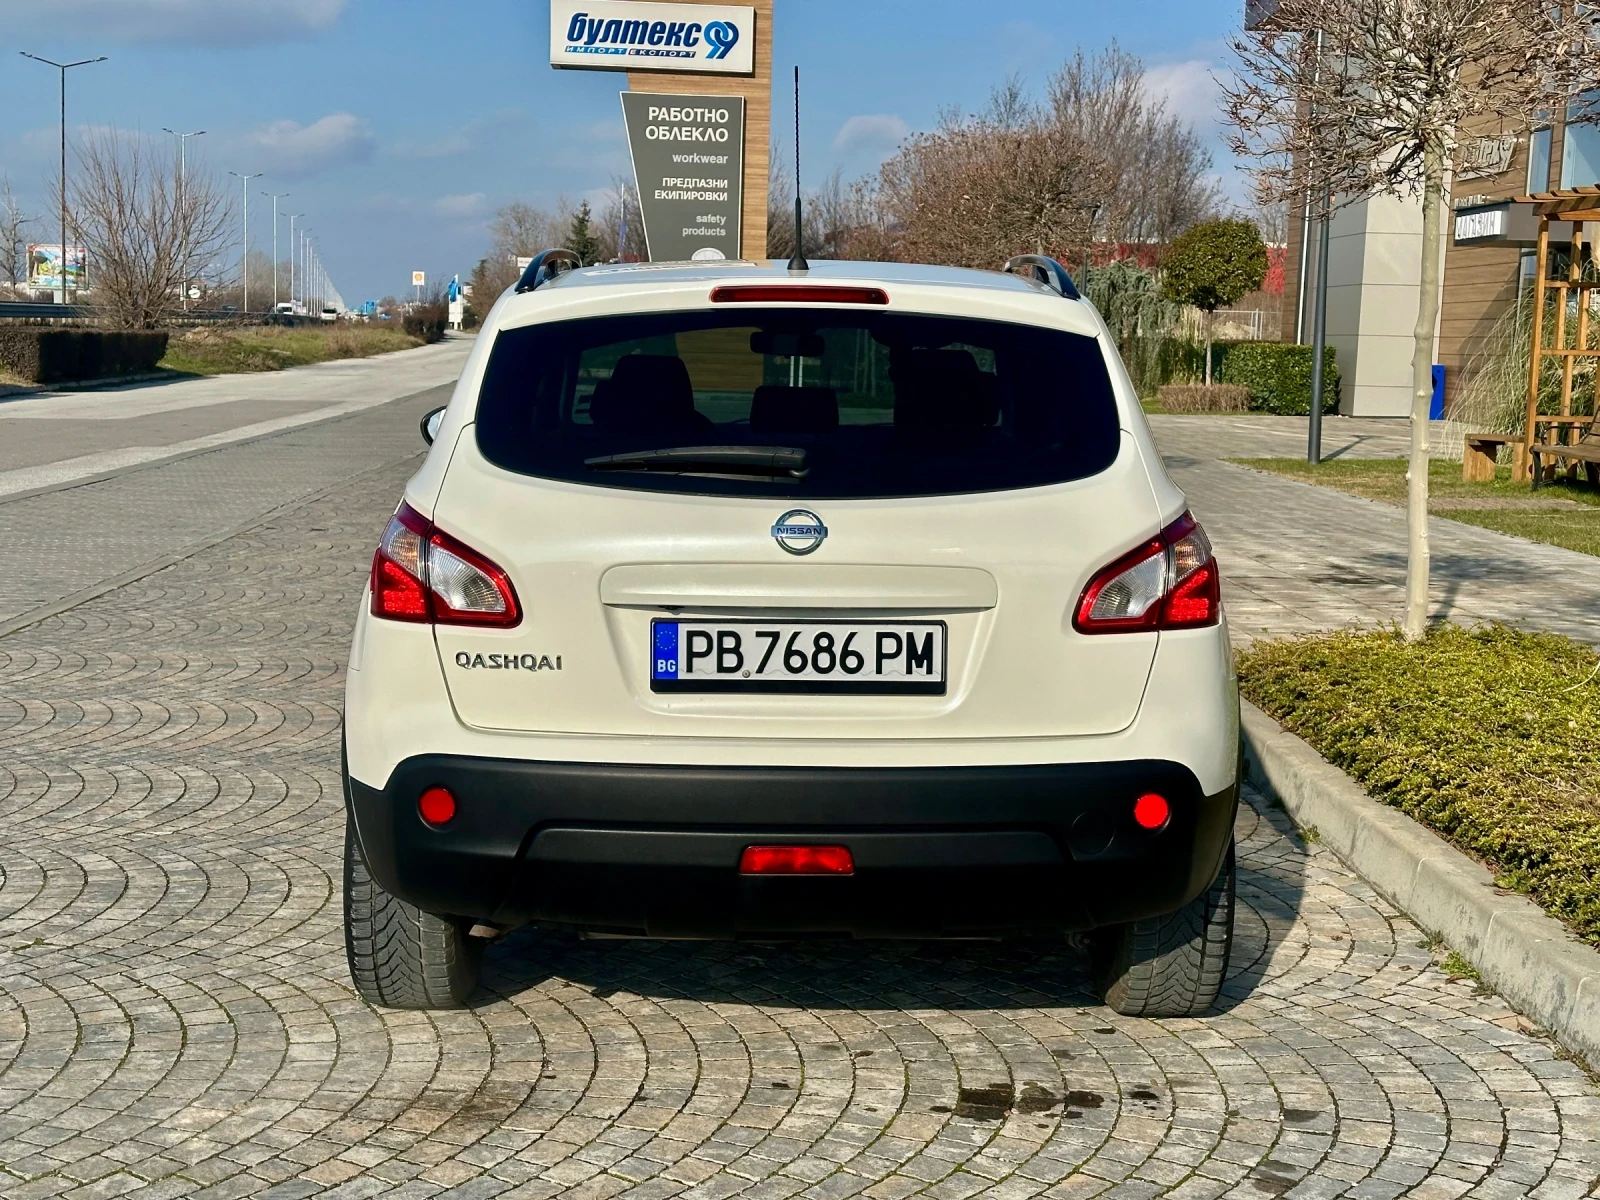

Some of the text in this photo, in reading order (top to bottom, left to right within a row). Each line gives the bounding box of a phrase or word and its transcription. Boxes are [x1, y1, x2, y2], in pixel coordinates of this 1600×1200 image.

[567, 13, 701, 47] бултекс
[566, 45, 697, 58] ИМПОРТ ЕКСПОРТ
[648, 106, 729, 123] РАБОТНО
[645, 125, 729, 142] ОБЛЕКЛО
[672, 152, 728, 164] workwear
[662, 177, 728, 189] ПРЕДПАЗНИ
[654, 189, 728, 201] ЕКИПИРОВКИ
[696, 214, 726, 225] safety
[682, 226, 726, 237] products
[776, 527, 822, 536] NISSAN
[685, 629, 934, 676] PB 7686 PM
[455, 651, 563, 672] QASHQAI
[657, 659, 676, 673] BG
